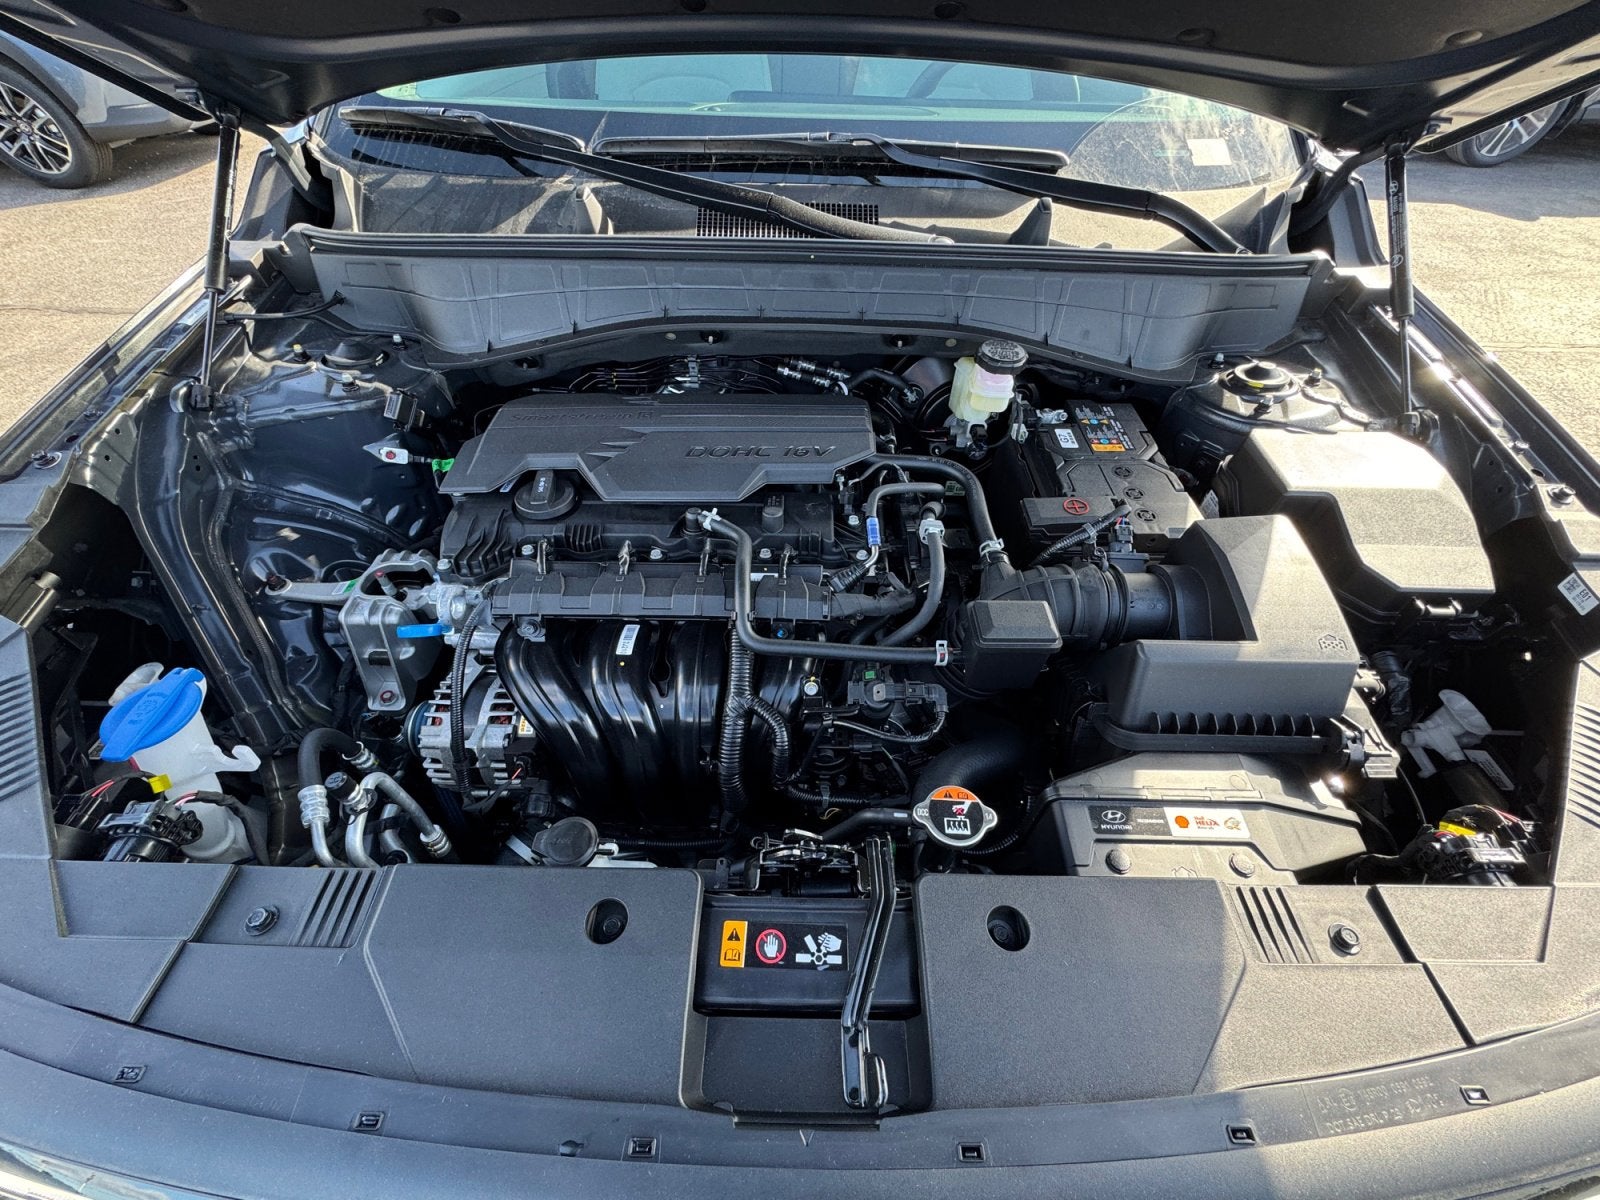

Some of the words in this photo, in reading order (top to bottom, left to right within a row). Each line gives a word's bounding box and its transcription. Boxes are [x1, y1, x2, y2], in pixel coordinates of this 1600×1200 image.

[684, 445, 776, 459] DOHC
[783, 444, 837, 458] 16V
[1100, 823, 1133, 831] HYUNDAI
